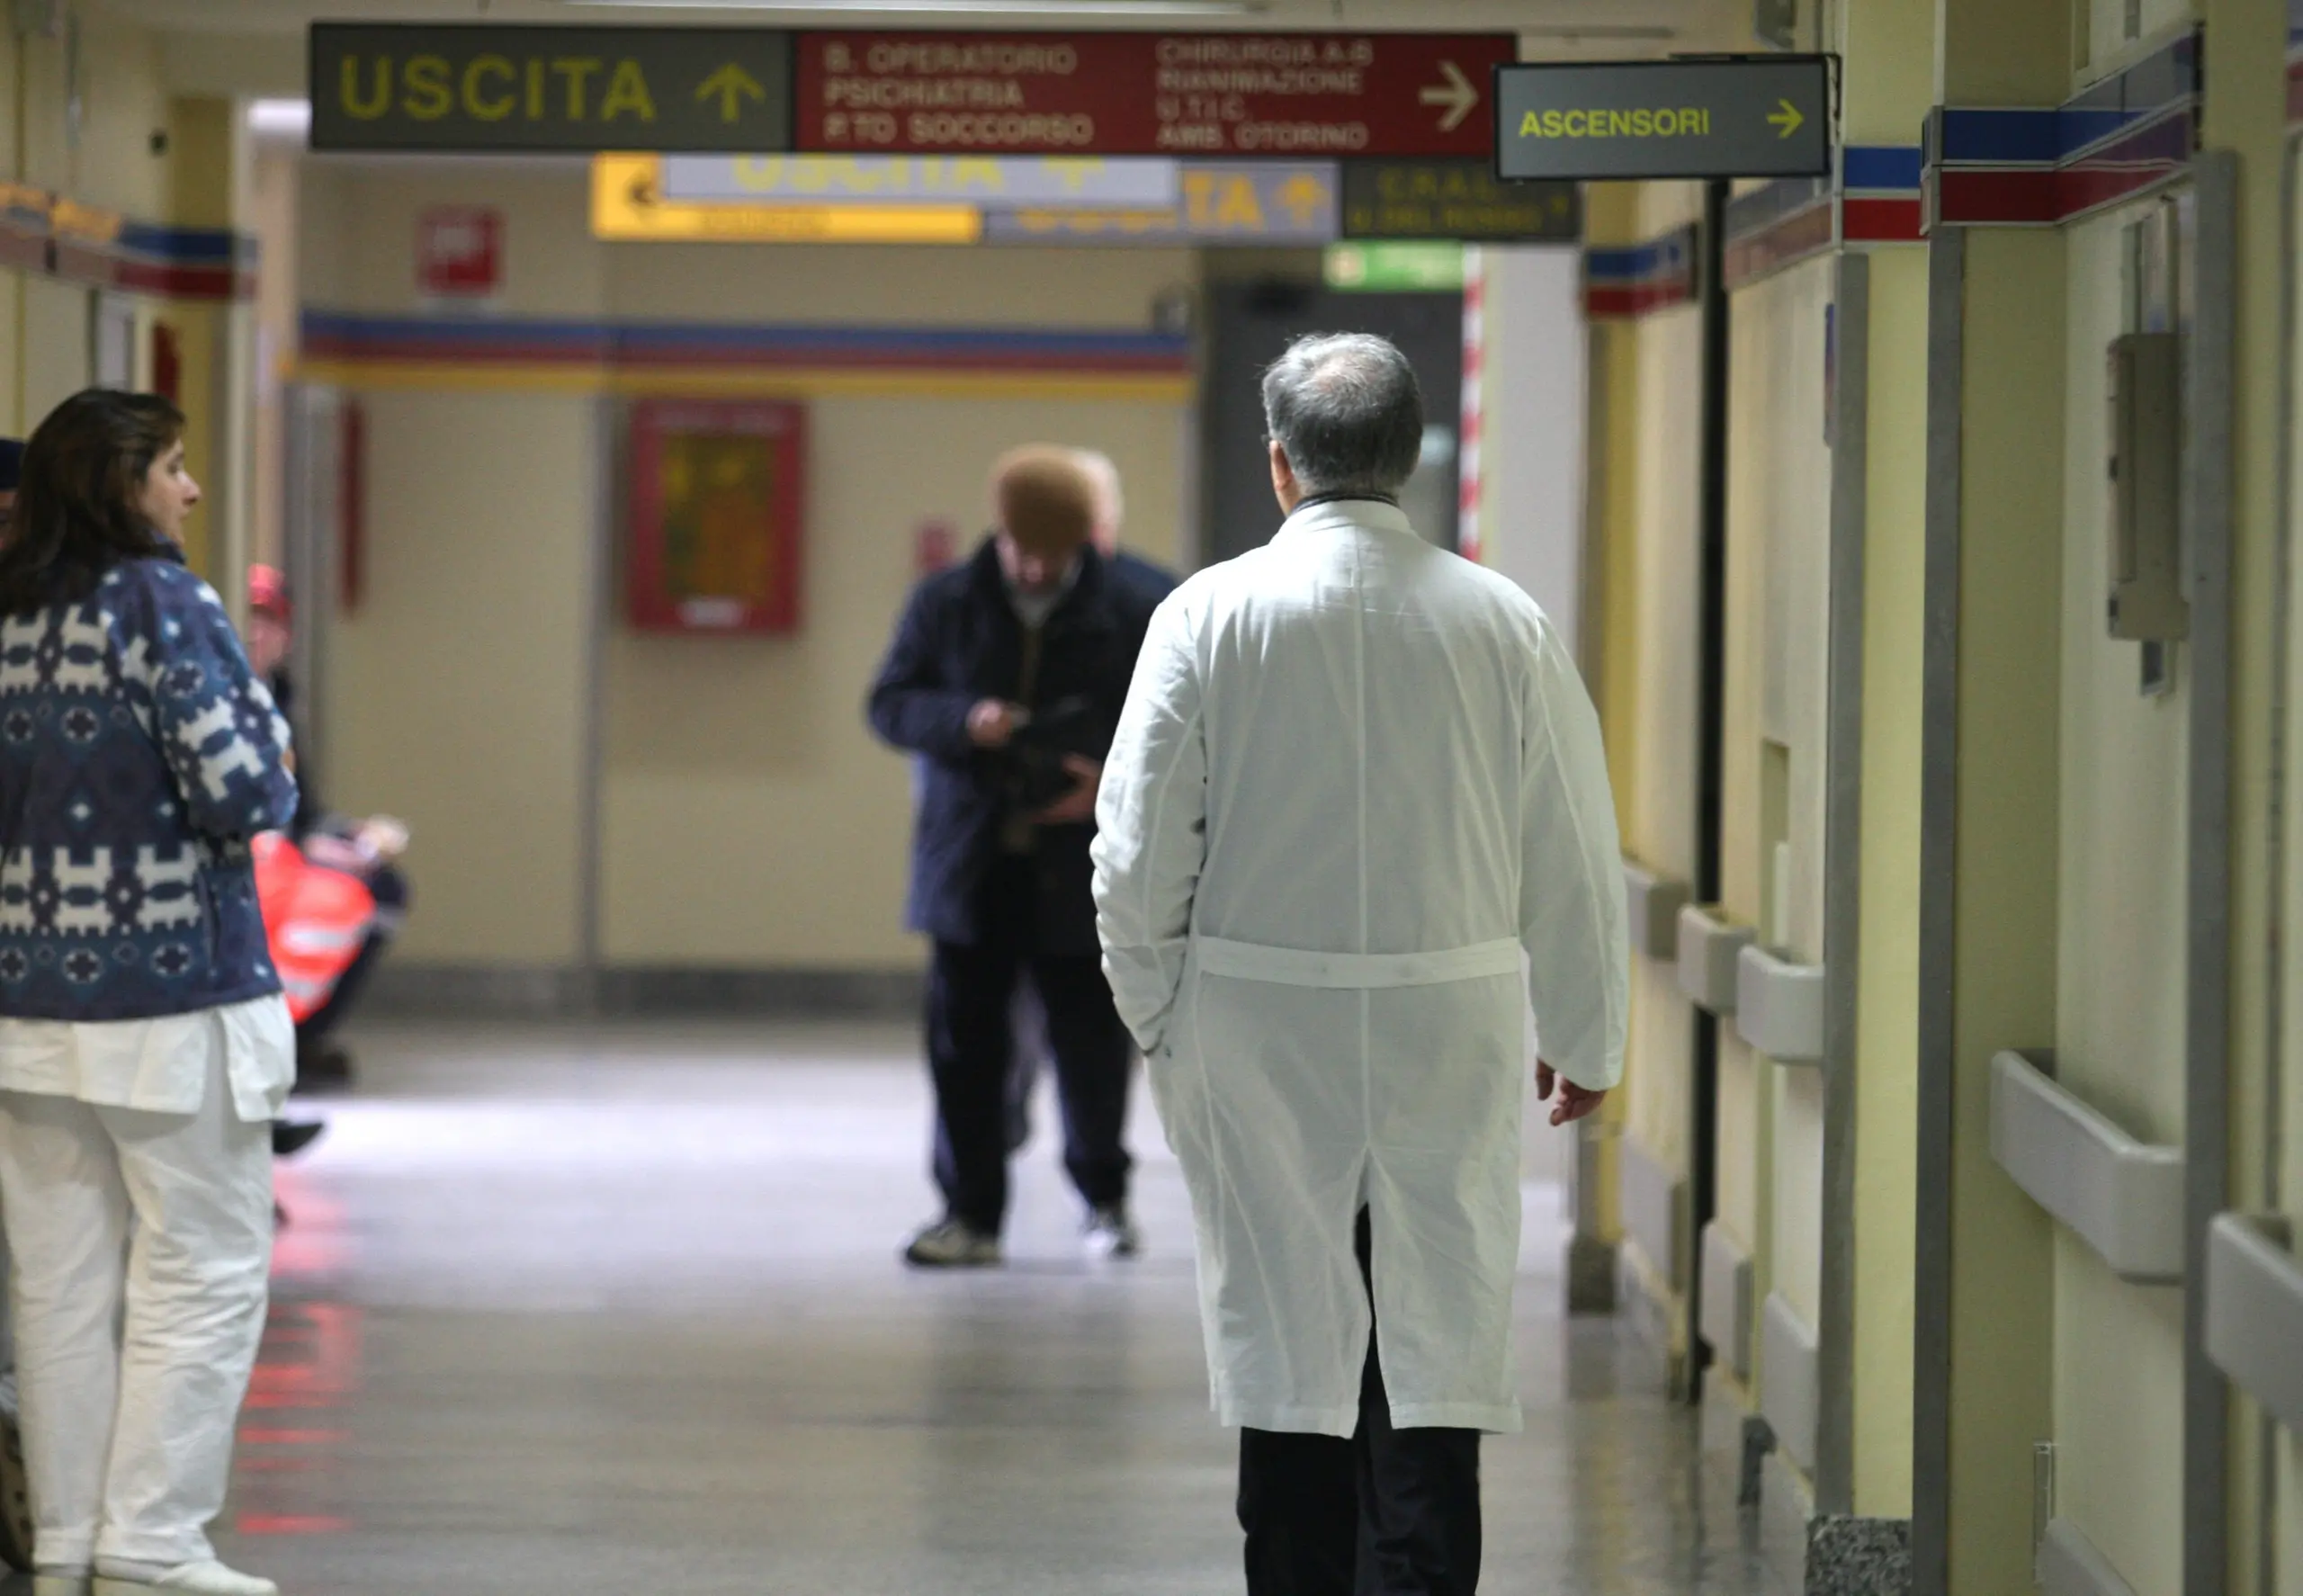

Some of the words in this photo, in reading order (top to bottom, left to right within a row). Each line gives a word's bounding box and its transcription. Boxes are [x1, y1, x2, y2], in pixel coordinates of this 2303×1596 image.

[868, 42, 1077, 74] OPERATORIO
[1155, 38, 1315, 67] CHIRURGIA
[340, 54, 656, 121] USCITA
[823, 76, 1025, 108] PSICHIATRIA
[1156, 67, 1364, 94] RIANIMAZIONE
[907, 112, 1093, 146] SOCCORSO
[1233, 121, 1369, 150] OTORINO
[1519, 107, 1709, 139] ASCENSORI
